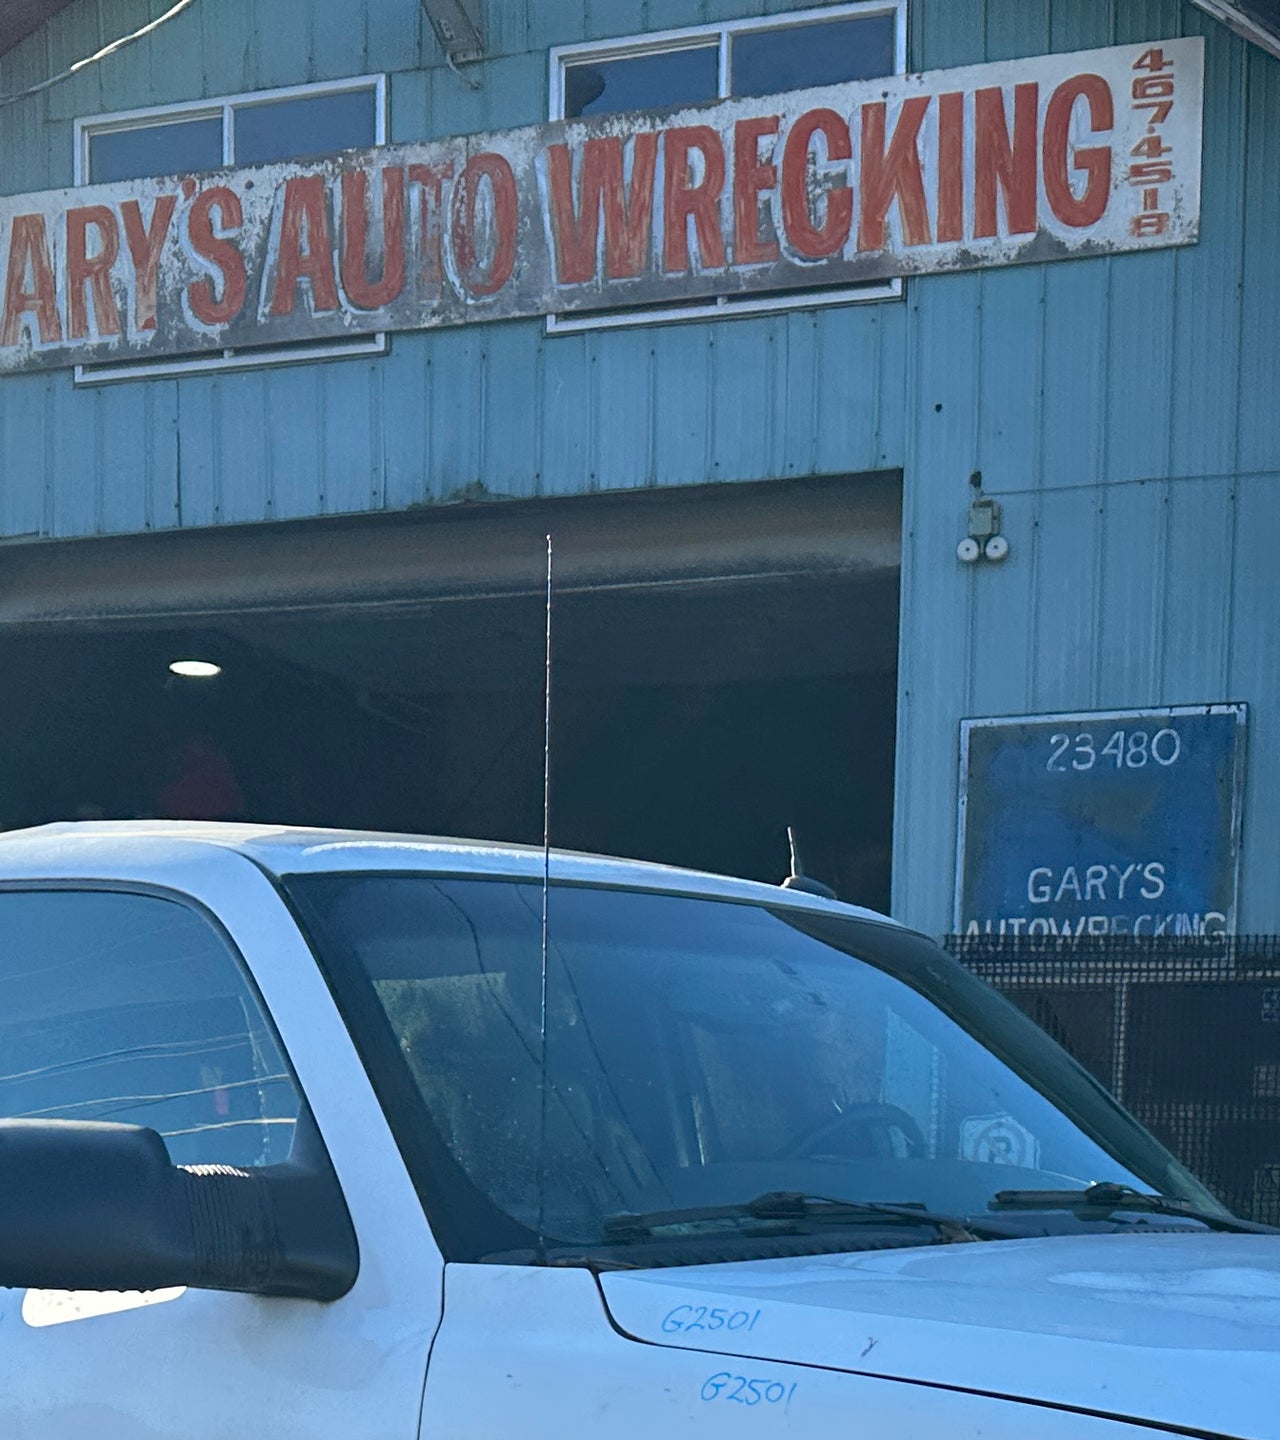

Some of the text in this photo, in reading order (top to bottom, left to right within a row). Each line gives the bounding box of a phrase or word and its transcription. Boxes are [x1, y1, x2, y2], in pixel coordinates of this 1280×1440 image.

[271, 154, 517, 316] AUTO
[548, 73, 1115, 285] WRECKING
[1046, 728, 1181, 773] 23480
[1027, 862, 1166, 904] GARY'S
[661, 1304, 761, 1333] G2501
[700, 1372, 798, 1406] G2501
